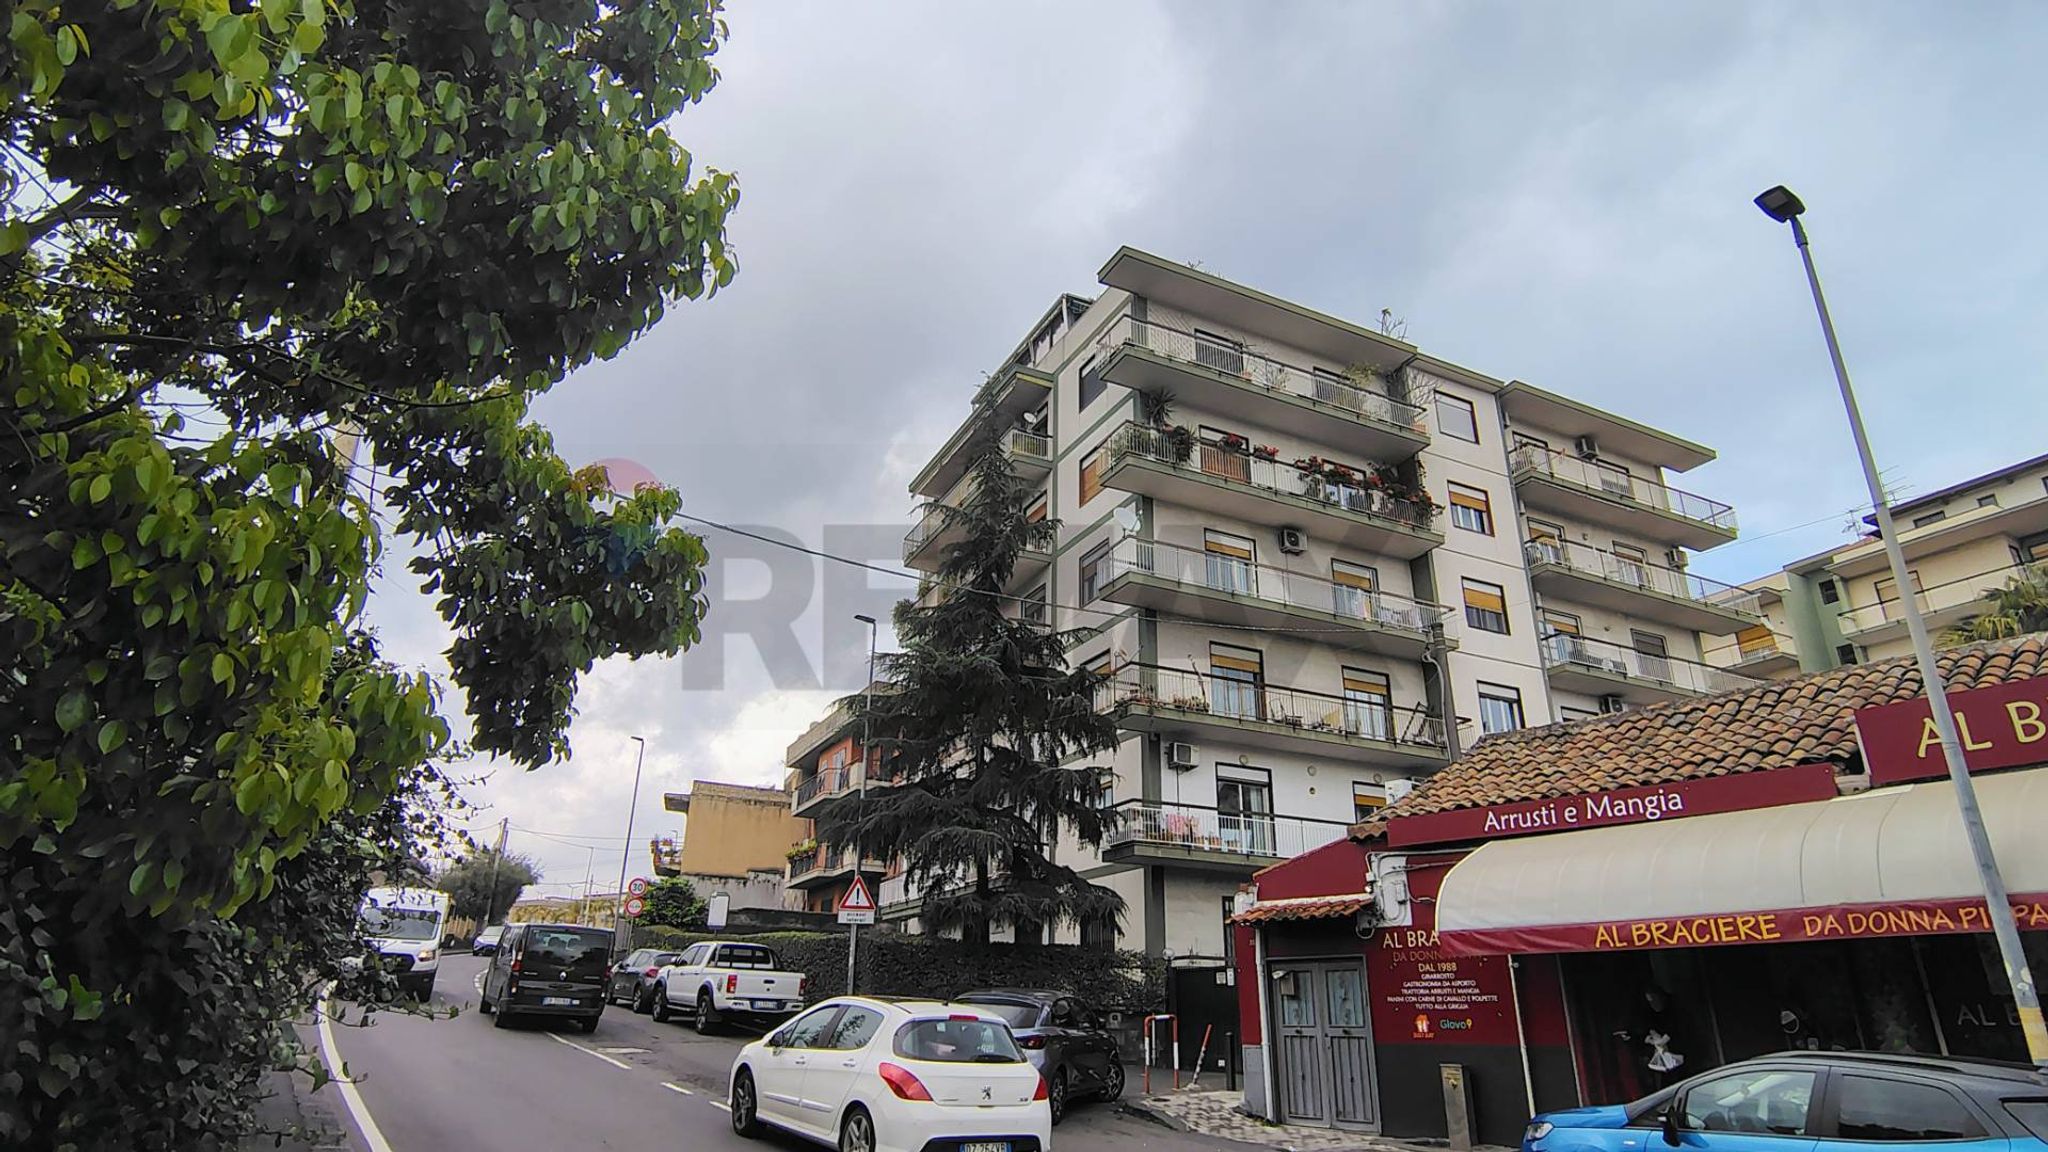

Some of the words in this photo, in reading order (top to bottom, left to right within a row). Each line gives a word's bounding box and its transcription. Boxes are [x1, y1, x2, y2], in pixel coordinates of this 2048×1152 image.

[1917, 711, 1993, 758] AL
[2005, 700, 2048, 744] B
[1483, 811, 1558, 832] Arrusti
[1565, 807, 1578, 823] e
[1586, 788, 1684, 820] Mangia
[633, 883, 643, 891] 30
[1595, 925, 1627, 949] AL
[1632, 914, 1782, 947] BRACIERE
[1803, 912, 1844, 938] DA
[1850, 908, 1955, 936] DONNA
[1957, 903, 2048, 932] PIPA
[1383, 932, 1403, 949] AL
[1392, 951, 1407, 962] DA
[1410, 950, 1448, 961] DONN
[1418, 963, 1436, 972] DAL
[1437, 962, 1457, 971] 1988
[1957, 1003, 1997, 1026] AL
[1440, 1018, 1467, 1029] Glovo
